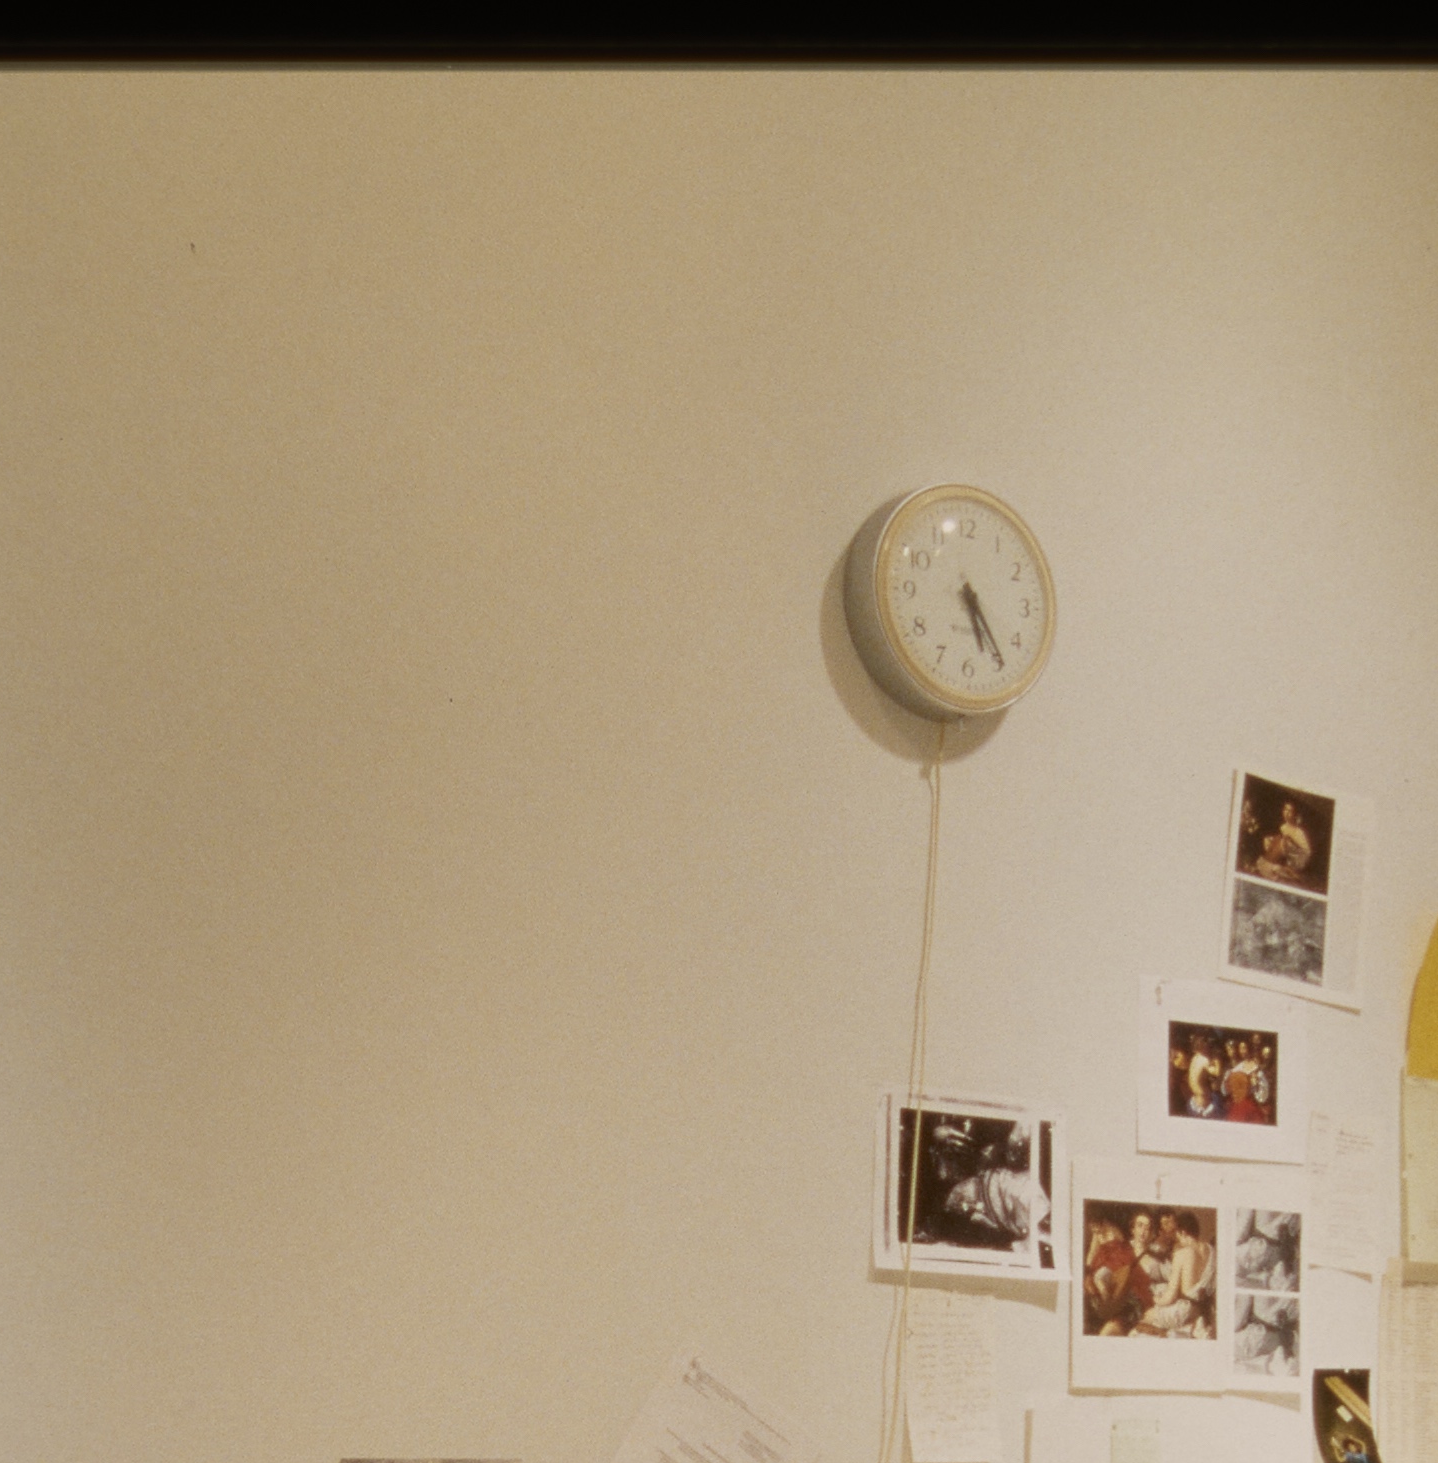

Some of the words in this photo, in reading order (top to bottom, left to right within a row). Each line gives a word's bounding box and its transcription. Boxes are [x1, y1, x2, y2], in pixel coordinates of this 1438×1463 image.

[958, 519, 977, 539] 12
[910, 550, 930, 570] 10
[1011, 562, 1021, 581] 2
[903, 581, 916, 599] 9
[1019, 599, 1030, 618] 3
[913, 618, 926, 636] 8
[1010, 632, 1022, 649] 4
[936, 646, 946, 663] 7
[962, 658, 974, 678] 6
